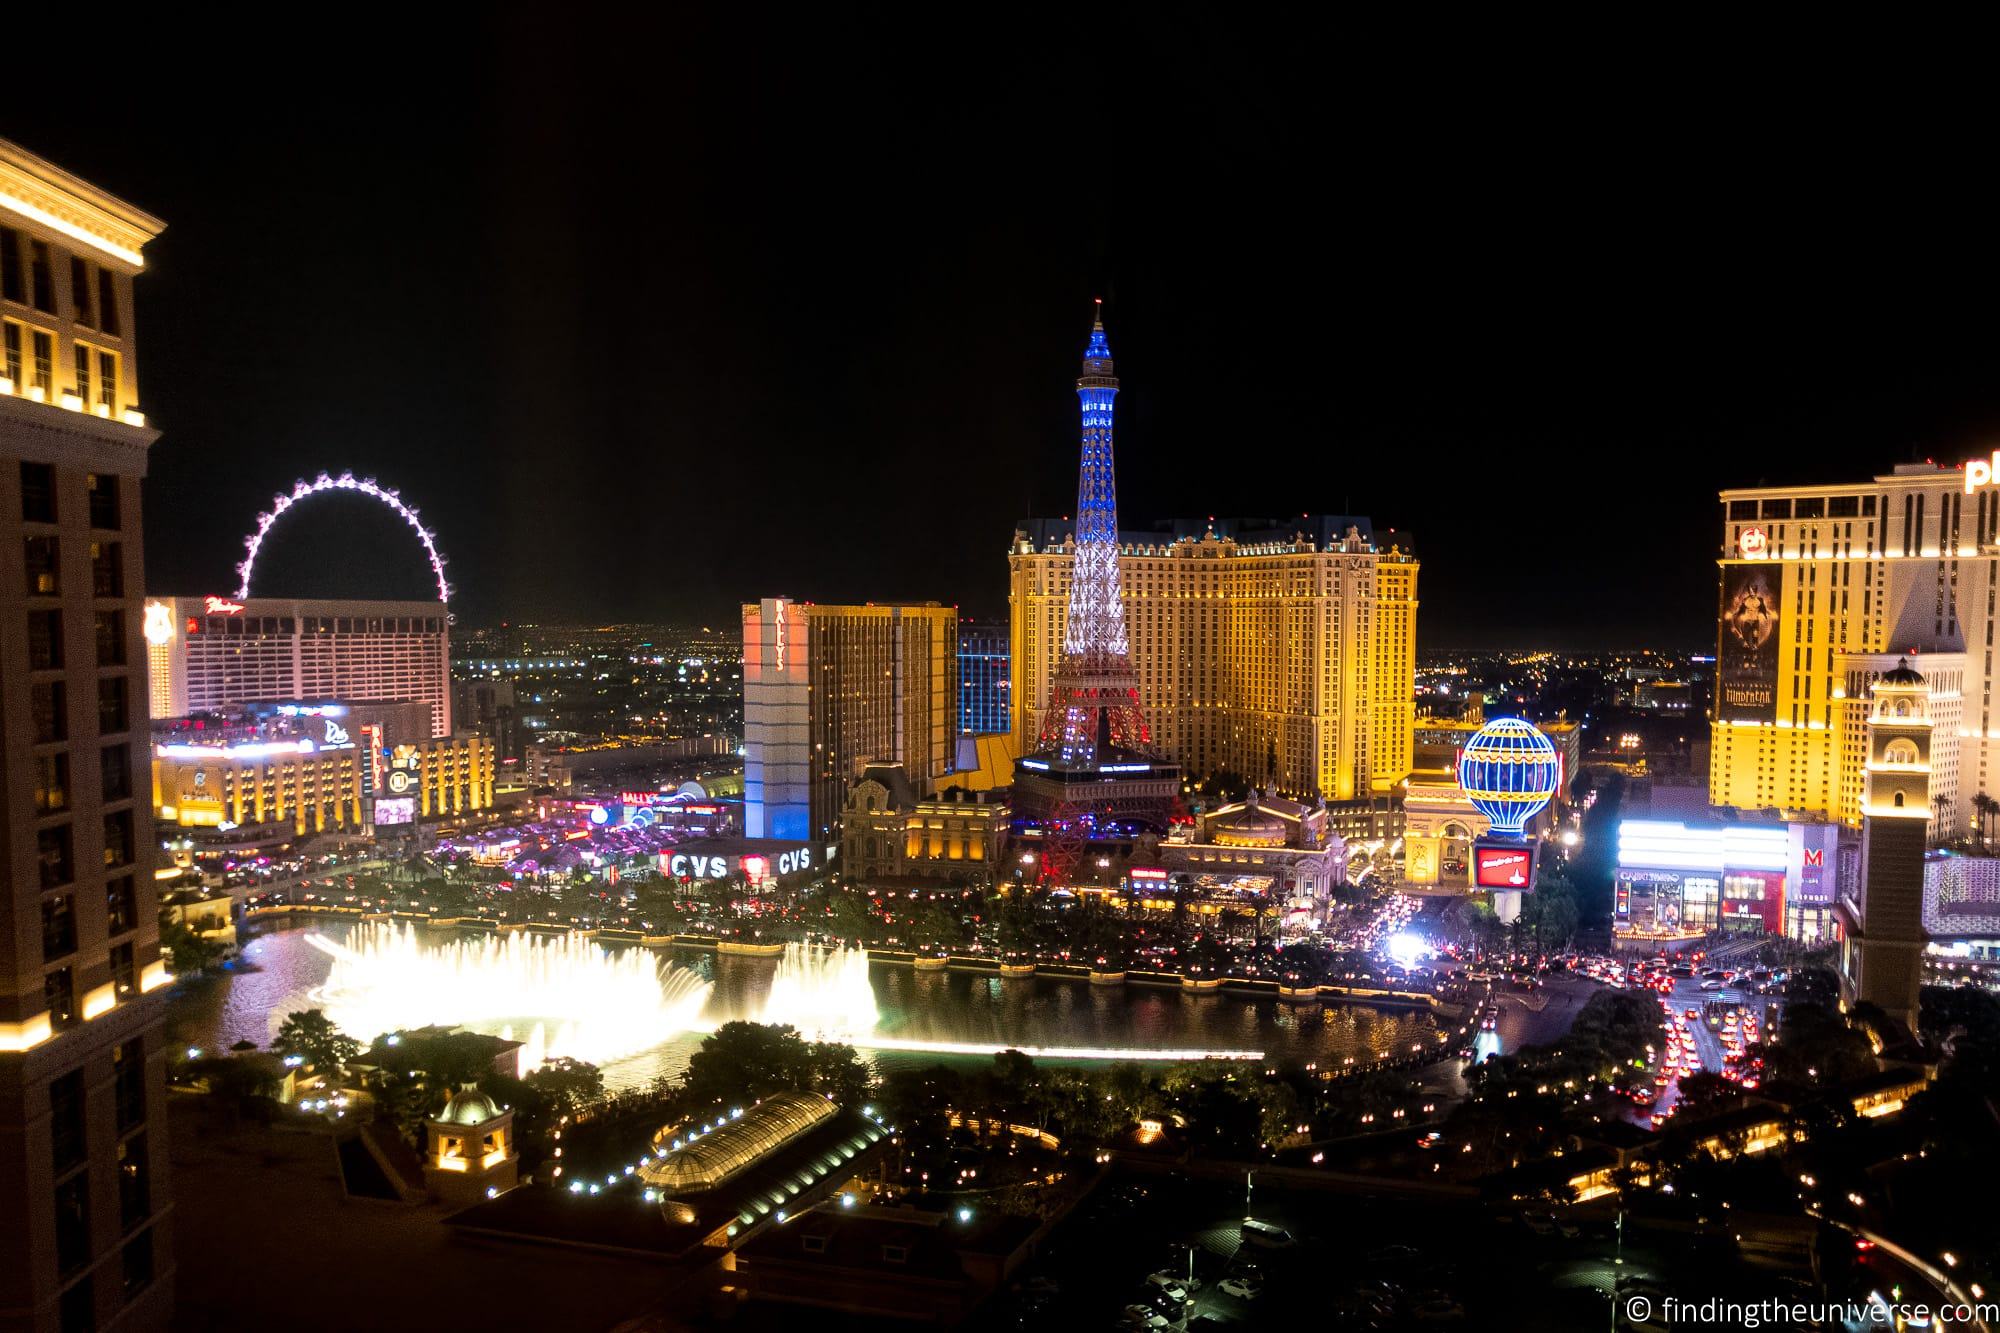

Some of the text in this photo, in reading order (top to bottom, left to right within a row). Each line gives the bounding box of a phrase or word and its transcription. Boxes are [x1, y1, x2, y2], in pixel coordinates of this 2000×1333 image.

[671, 854, 728, 878] CVS
[779, 847, 810, 875] CVS
[1804, 847, 1824, 866] M
